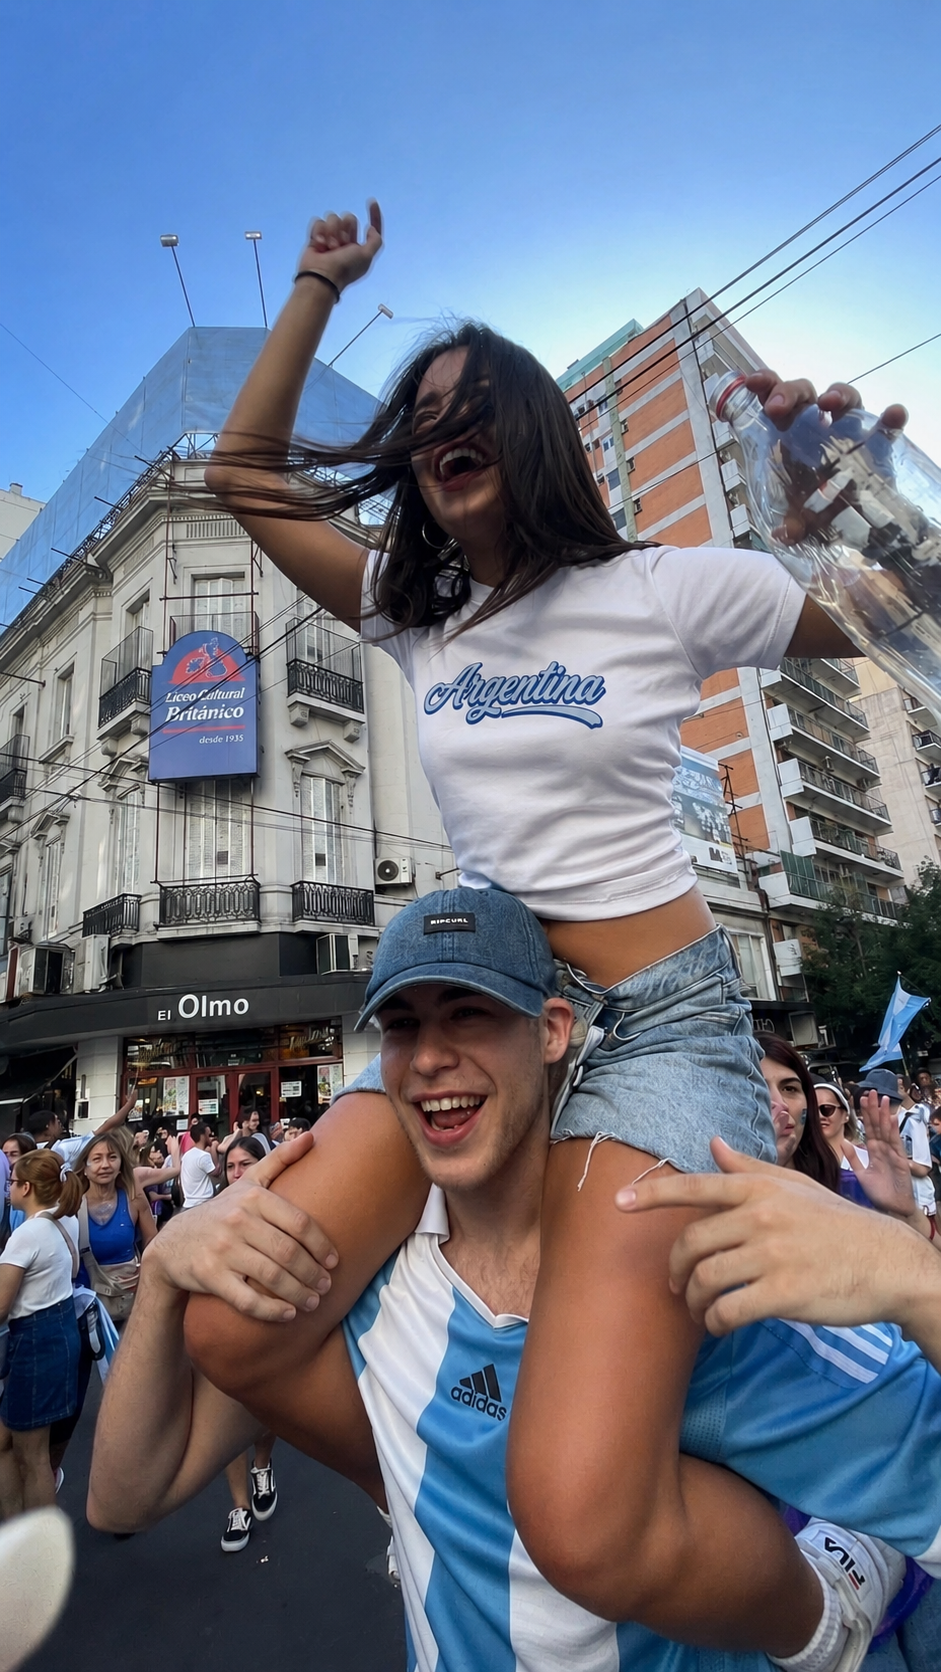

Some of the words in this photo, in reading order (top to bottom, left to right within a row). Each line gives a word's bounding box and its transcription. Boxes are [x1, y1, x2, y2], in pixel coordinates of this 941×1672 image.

[165, 690, 197, 702] Liceo
[198, 687, 246, 701] Cultural
[424, 661, 606, 725] Argentina
[164, 704, 244, 722] Británico
[199, 735, 223, 744] desde
[225, 734, 244, 743] 1935
[157, 1010, 171, 1021] El
[178, 993, 250, 1019] Olmo
[450, 1386, 507, 1421] adidas
[824, 1536, 866, 1591] FILA
